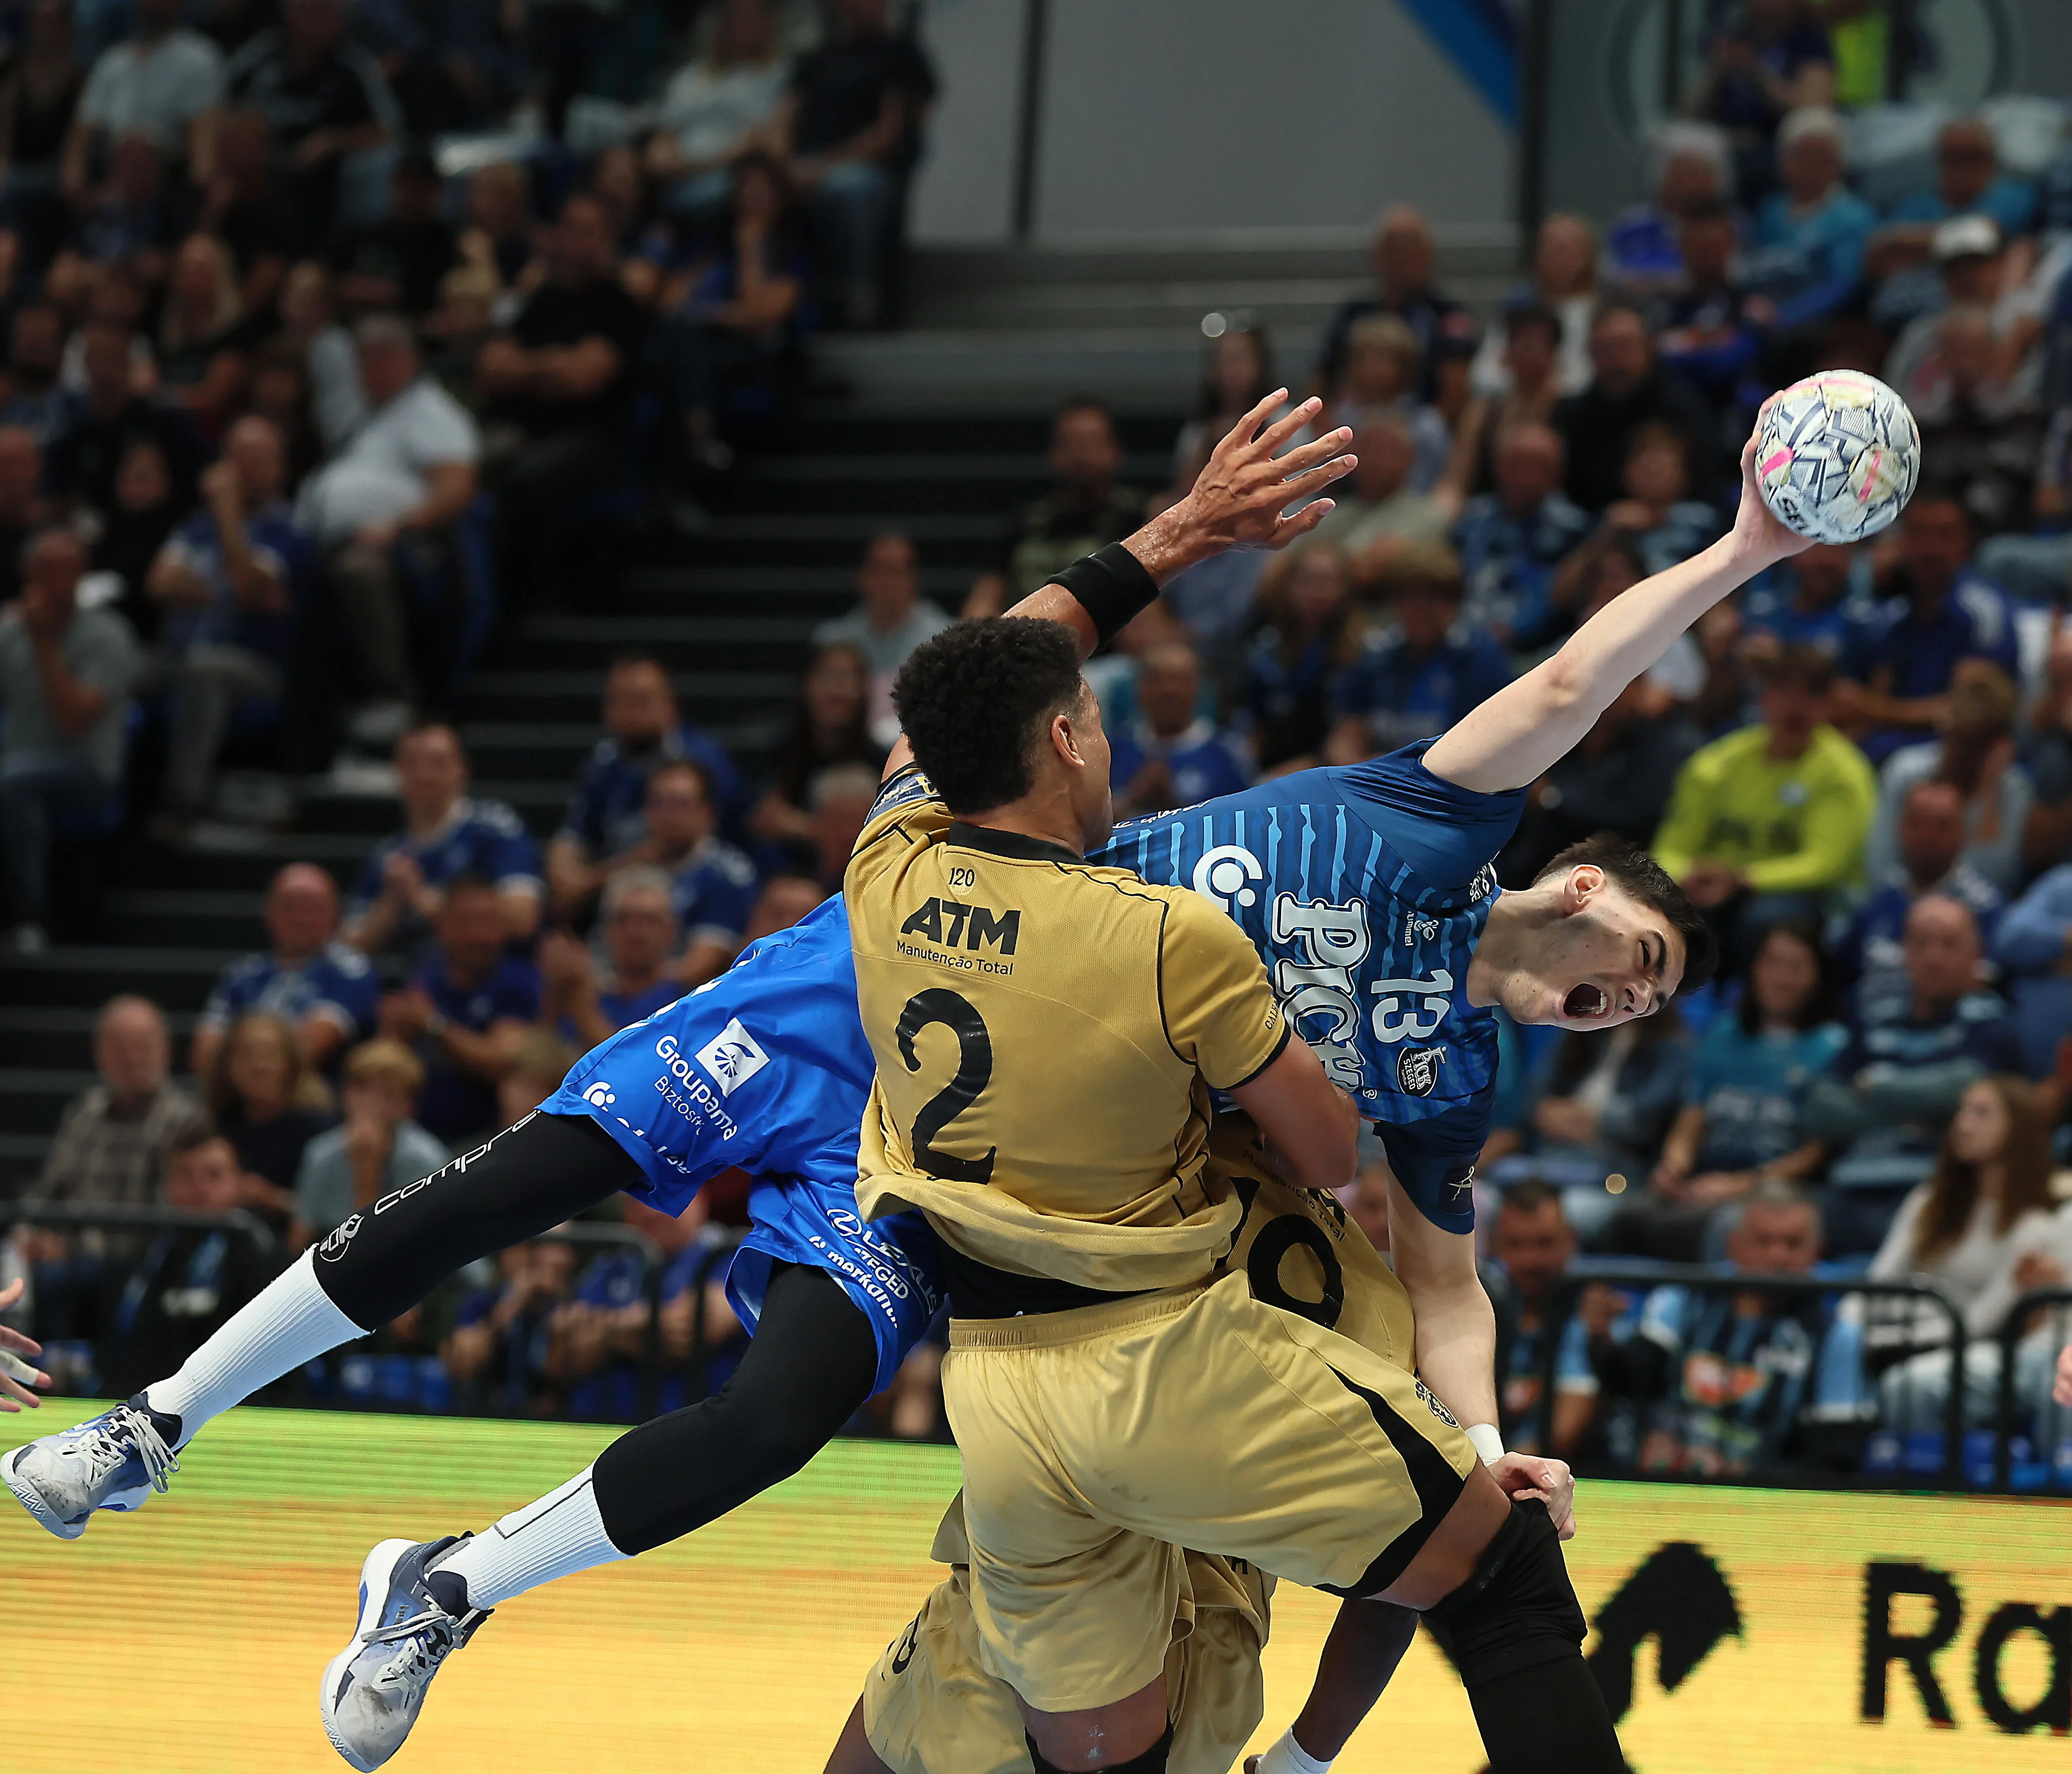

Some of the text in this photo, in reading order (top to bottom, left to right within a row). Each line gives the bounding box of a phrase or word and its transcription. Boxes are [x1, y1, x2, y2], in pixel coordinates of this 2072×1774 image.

[948, 867, 975, 887] 120
[900, 897, 1021, 955] ATM
[897, 940, 1013, 976] Manutenção Total
[1273, 892, 1370, 1092] PICK
[1371, 969, 1454, 1043] 13
[655, 1035, 738, 1142] Groupama
[895, 987, 997, 1186] 2
[1403, 1058, 1416, 1090] SZEGED
[1413, 1049, 1439, 1090] PICK
